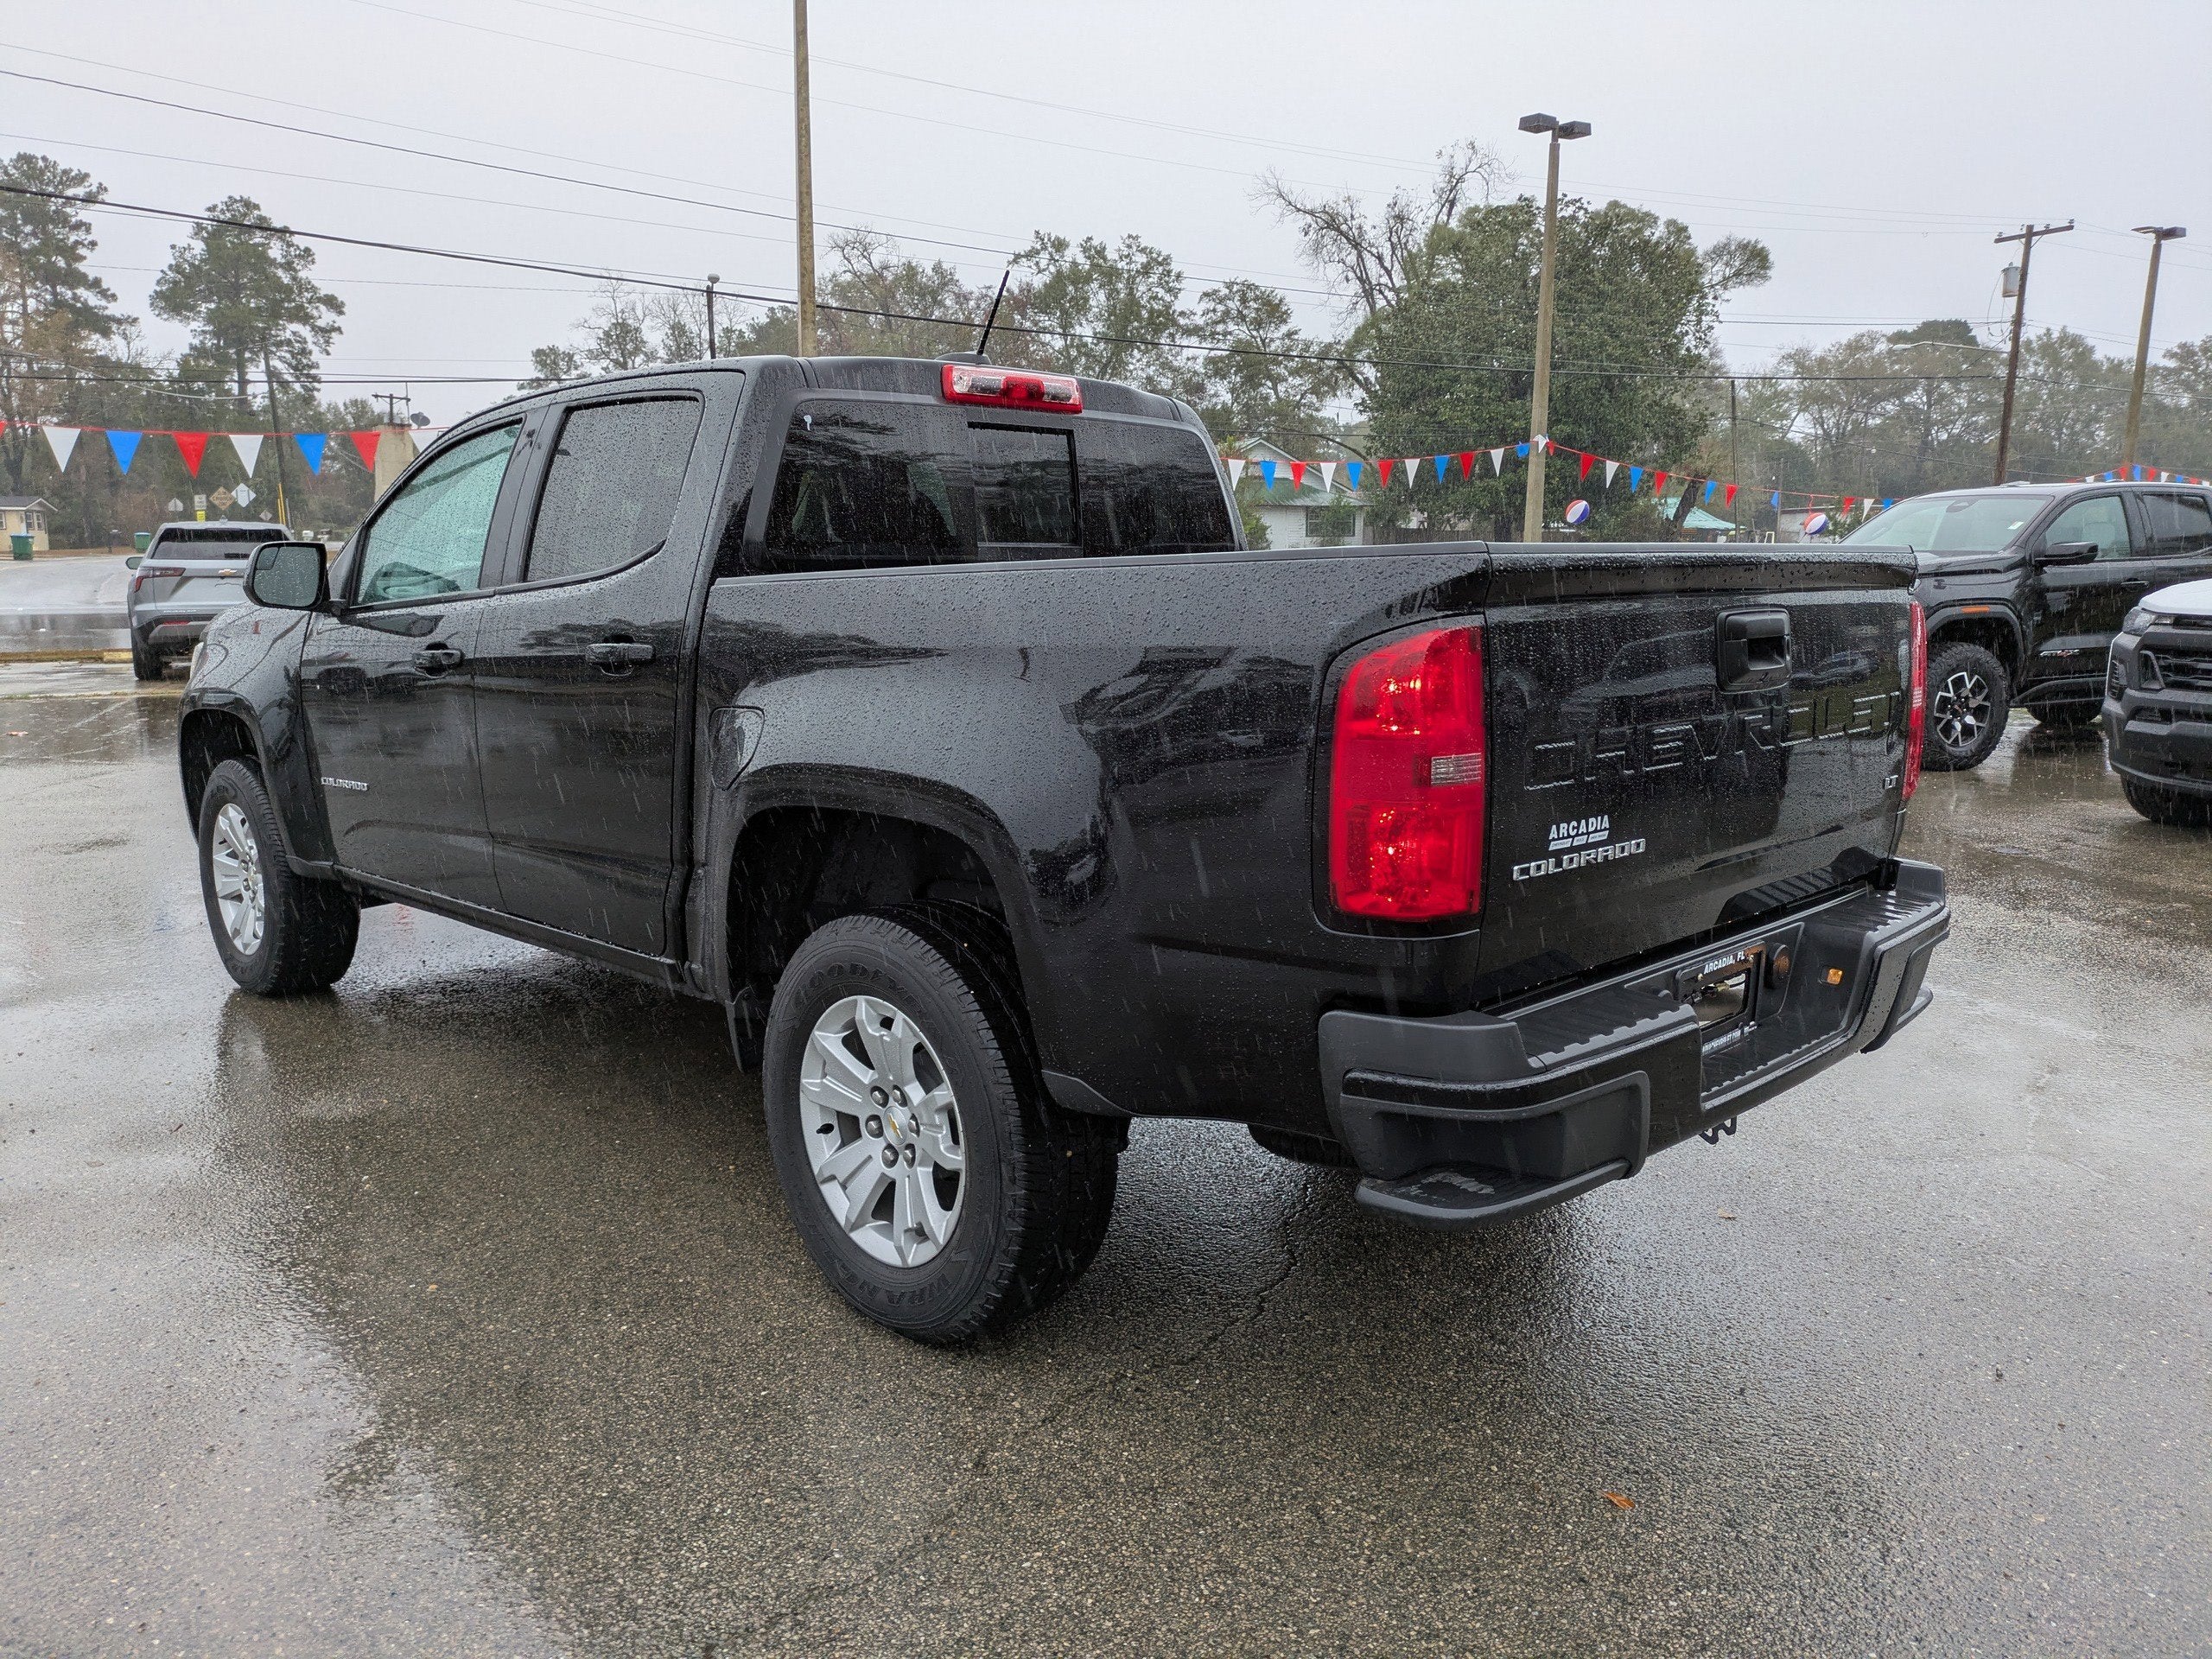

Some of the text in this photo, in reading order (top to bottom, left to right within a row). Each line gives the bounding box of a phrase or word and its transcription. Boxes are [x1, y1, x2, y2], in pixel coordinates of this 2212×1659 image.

[1523, 691, 1901, 791] CHEVROLET
[321, 777, 369, 791] COLORADO
[1885, 774, 1898, 790] LT
[1548, 815, 1610, 840] ARCADIA
[1513, 839, 1646, 881] COLORADO
[1704, 950, 1745, 975] ARCADIA, FL
